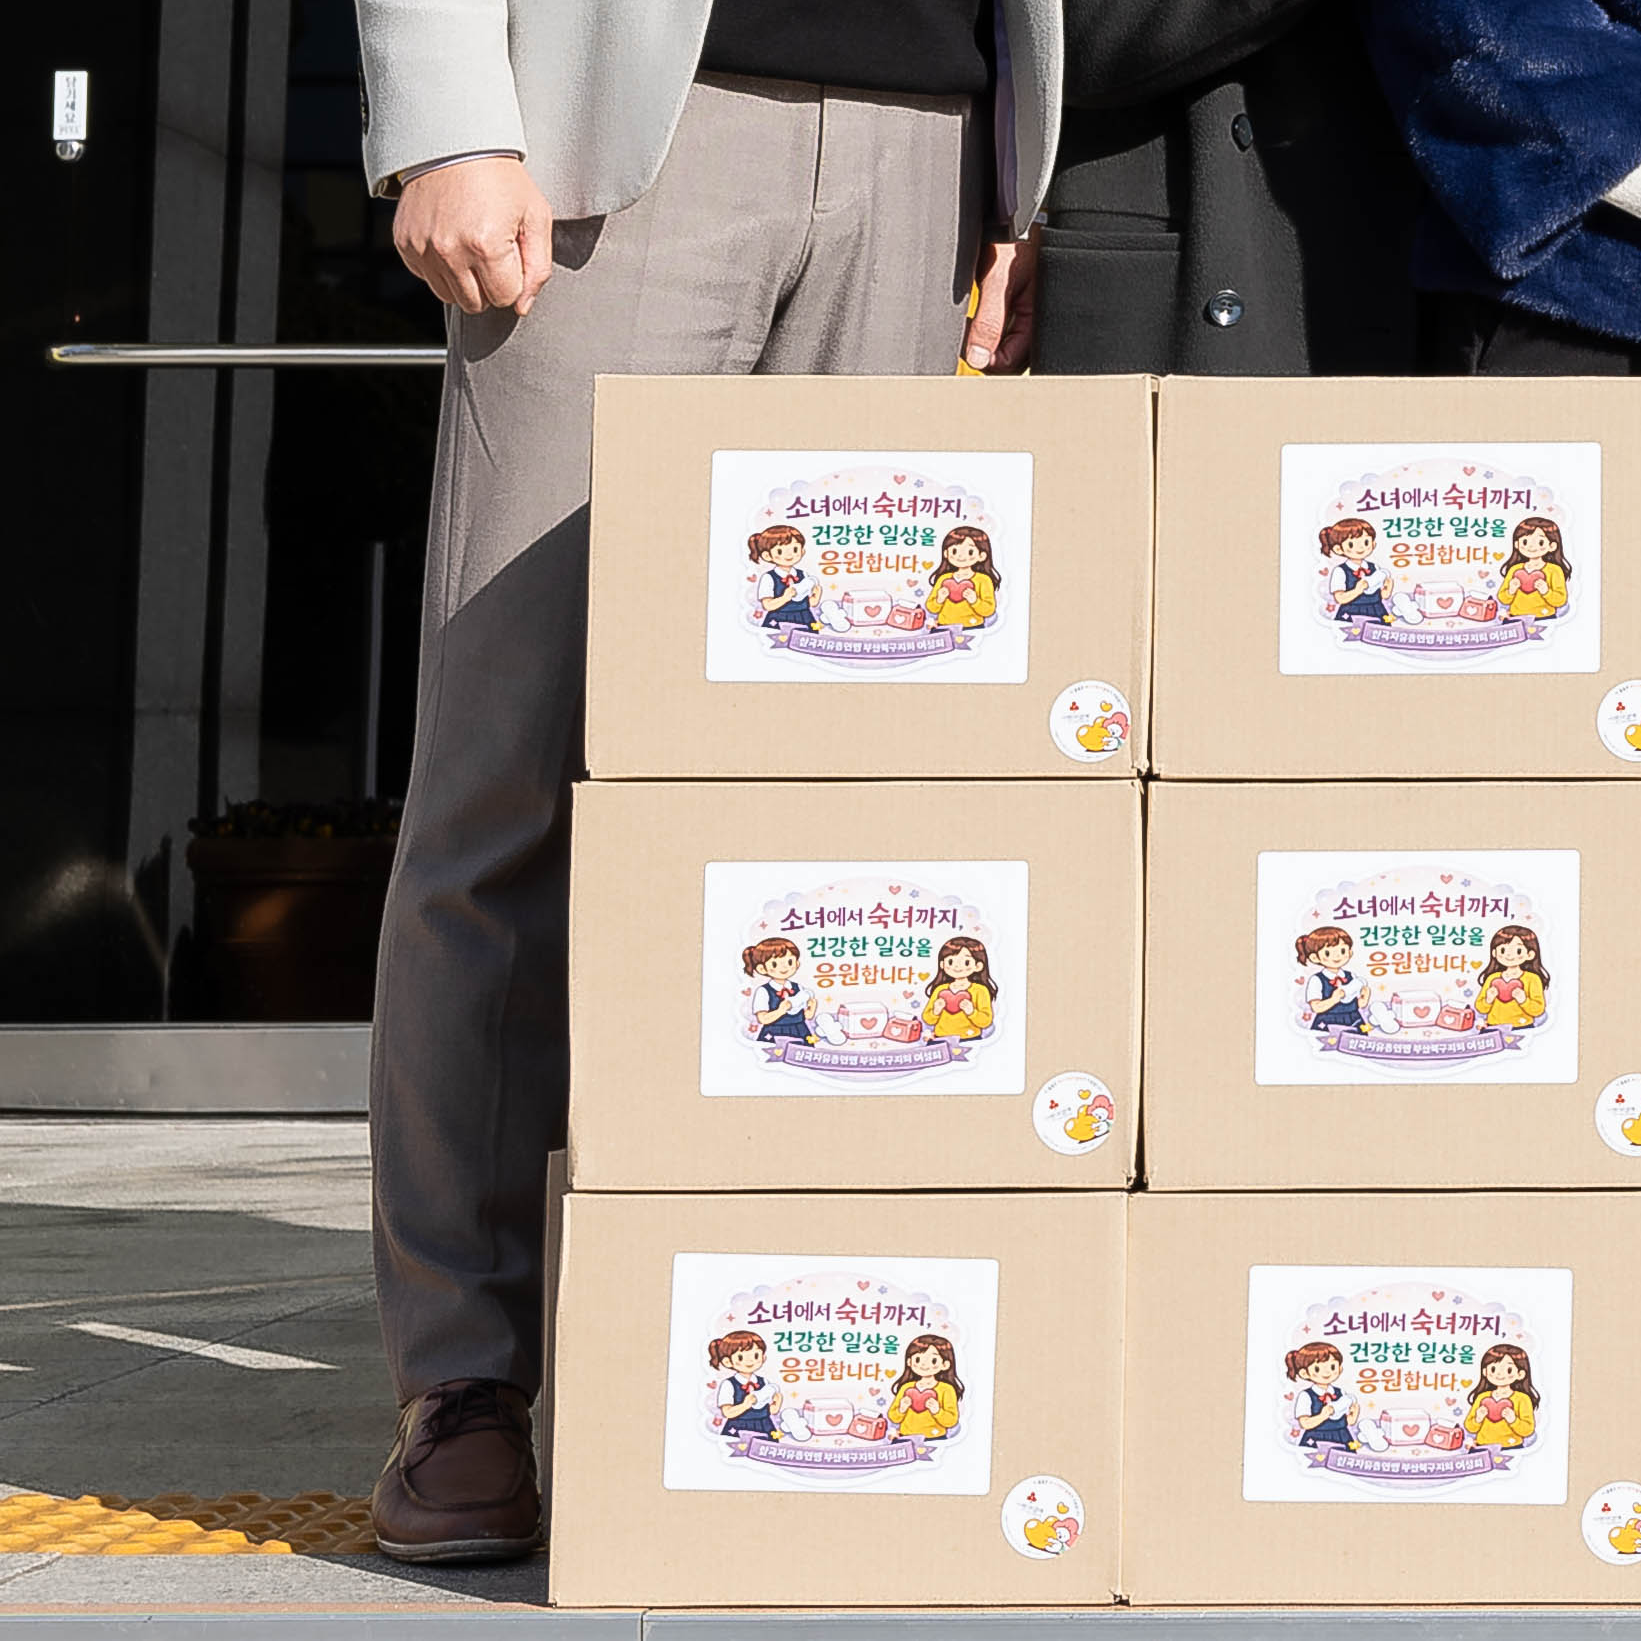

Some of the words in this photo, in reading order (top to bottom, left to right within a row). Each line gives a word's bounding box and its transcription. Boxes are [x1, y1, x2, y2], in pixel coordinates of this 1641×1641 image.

[785, 494, 868, 520] 소녀에서
[1355, 487, 1438, 513] 소녀에서
[811, 524, 875, 546] 건강한
[878, 524, 937, 547] 일상을
[1382, 516, 1445, 538] 건강한
[1449, 516, 1507, 538] 일상을
[780, 906, 863, 932] 소녀에서
[806, 936, 870, 958] 건강한
[874, 935, 933, 958] 일상을
[747, 1300, 831, 1325] 소녀에서
[1323, 1311, 1406, 1337] 소녀에서
[773, 1330, 837, 1353] 건강한
[841, 1331, 900, 1355] 일상을
[1349, 1341, 1413, 1363] 건강한
[1416, 1342, 1475, 1365] 일상을
